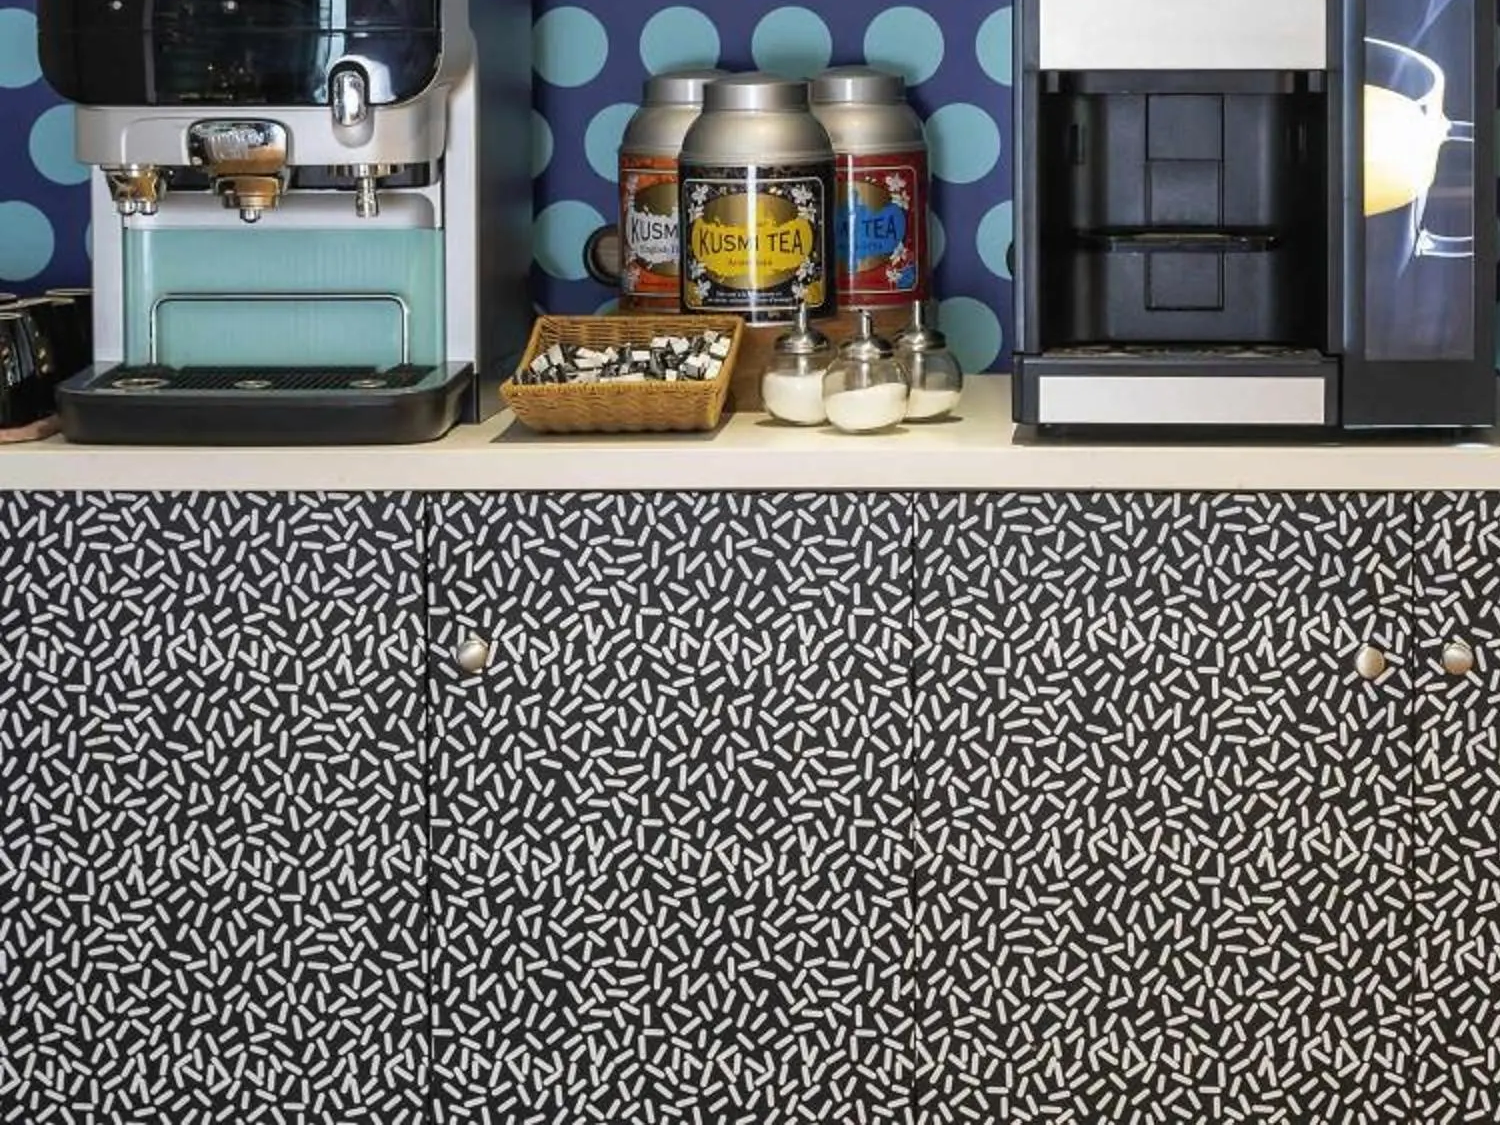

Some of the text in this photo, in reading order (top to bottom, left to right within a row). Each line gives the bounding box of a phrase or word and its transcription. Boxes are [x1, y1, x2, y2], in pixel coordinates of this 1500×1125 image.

[631, 216, 679, 244] KUSM
[699, 227, 804, 257] KUSMI TEA
[861, 216, 897, 240] TEA
